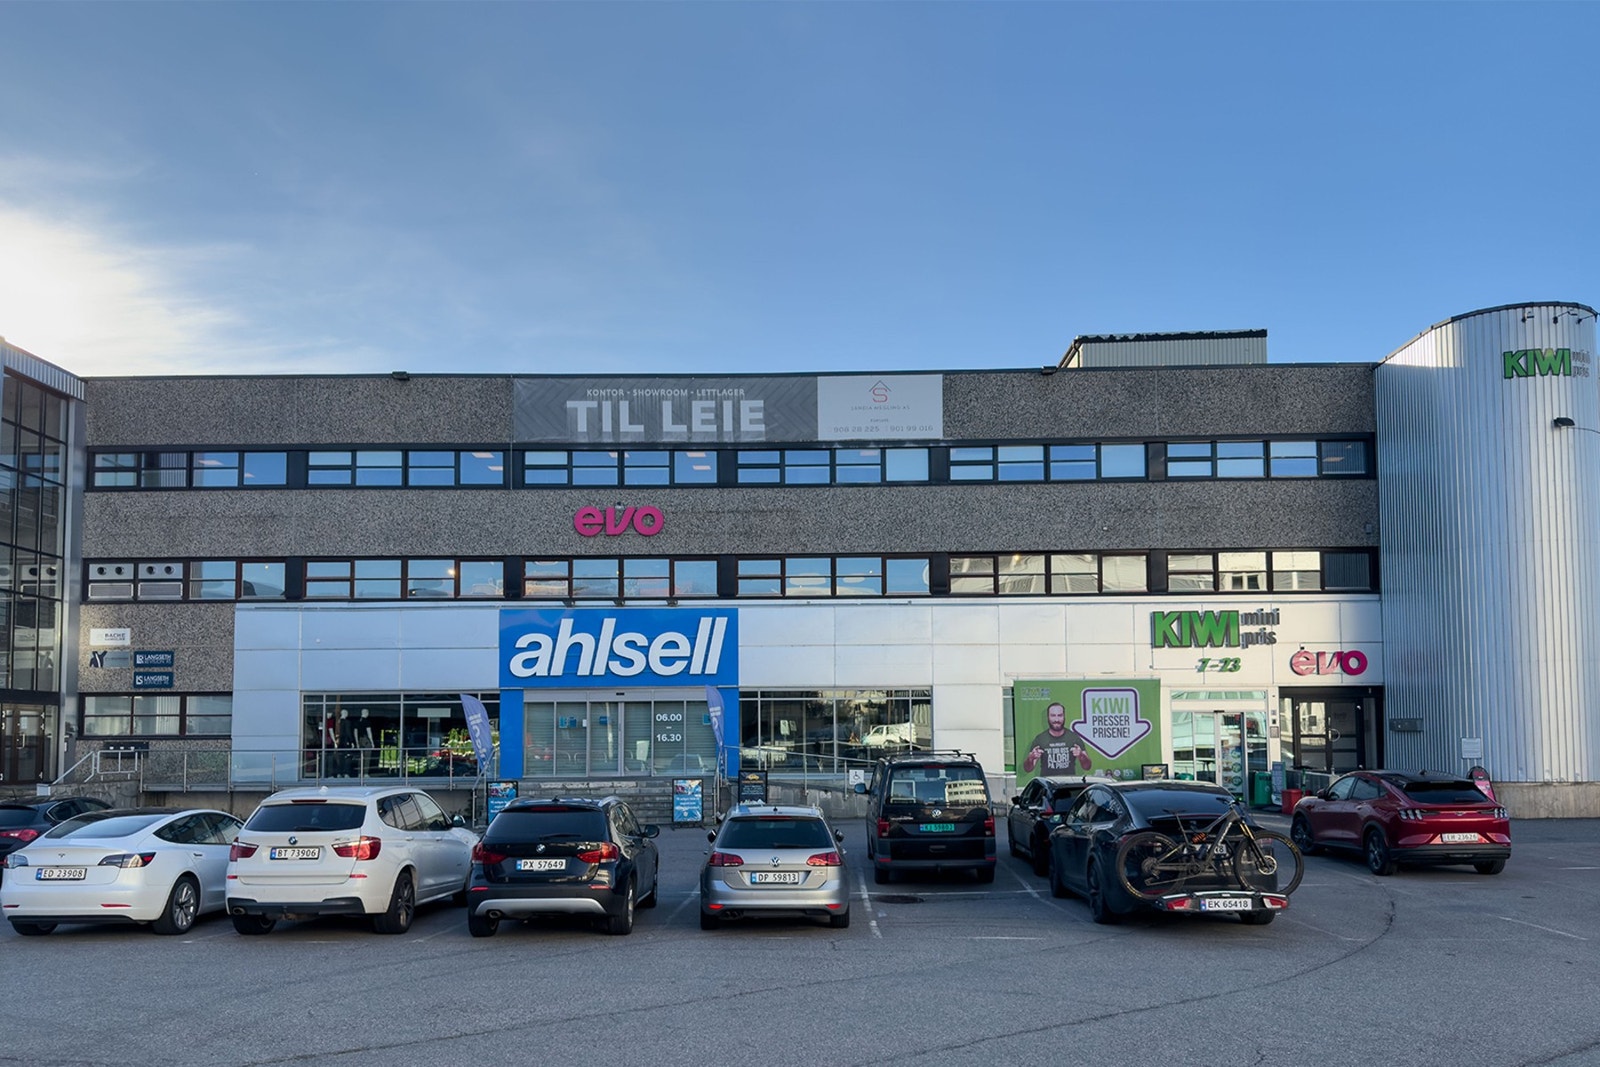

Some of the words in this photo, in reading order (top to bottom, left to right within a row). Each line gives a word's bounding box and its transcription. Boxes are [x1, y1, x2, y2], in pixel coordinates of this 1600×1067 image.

[1503, 348, 1572, 379] KIWI
[587, 388, 625, 397] KONTOR
[632, 388, 688, 397] SHOWROOM
[696, 388, 745, 397] LETTLAGER
[566, 400, 645, 432] TIL
[662, 400, 766, 432] LEIE
[573, 506, 664, 537] evo
[1151, 610, 1239, 648] KIWI
[1241, 608, 1280, 625] mini
[1241, 628, 1277, 648] pris
[509, 617, 728, 677] ahlsell
[1291, 650, 1368, 676] evo
[1091, 697, 1129, 714] KIWI
[656, 713, 682, 721] 06.00
[1092, 715, 1130, 726] PRESSER
[656, 733, 682, 741] 16.30
[1092, 727, 1131, 738] PRISENE!
[277, 849, 287, 857] BT
[290, 849, 317, 857] 73906
[523, 861, 535, 869] PX
[538, 861, 563, 869] 57649
[43, 869, 54, 877] ED
[57, 869, 83, 877] 23908
[1208, 900, 1220, 908] EK
[1223, 900, 1249, 908] 65418
